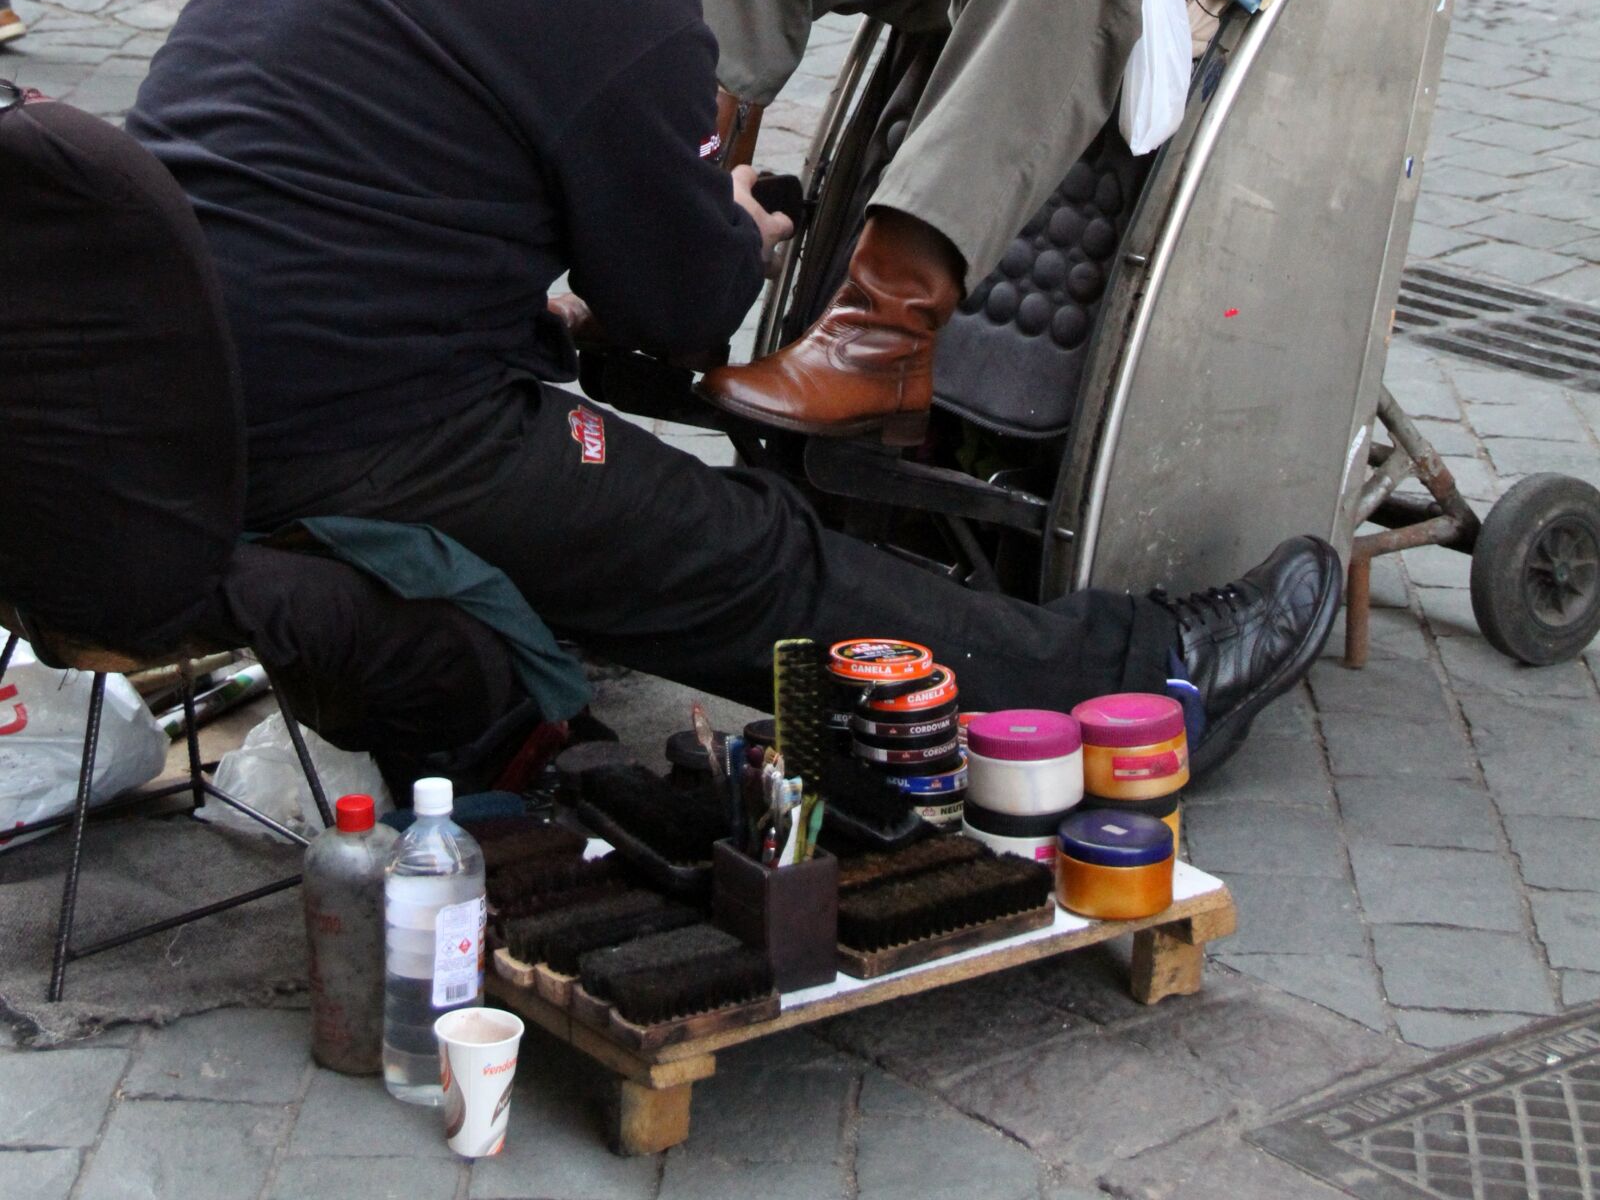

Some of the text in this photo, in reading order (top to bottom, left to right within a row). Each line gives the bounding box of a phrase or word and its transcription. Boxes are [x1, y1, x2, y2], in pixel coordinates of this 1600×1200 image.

[850, 663, 893, 674] CANELA
[907, 687, 945, 703] CANELA
[909, 719, 951, 734] CORDOVAN
